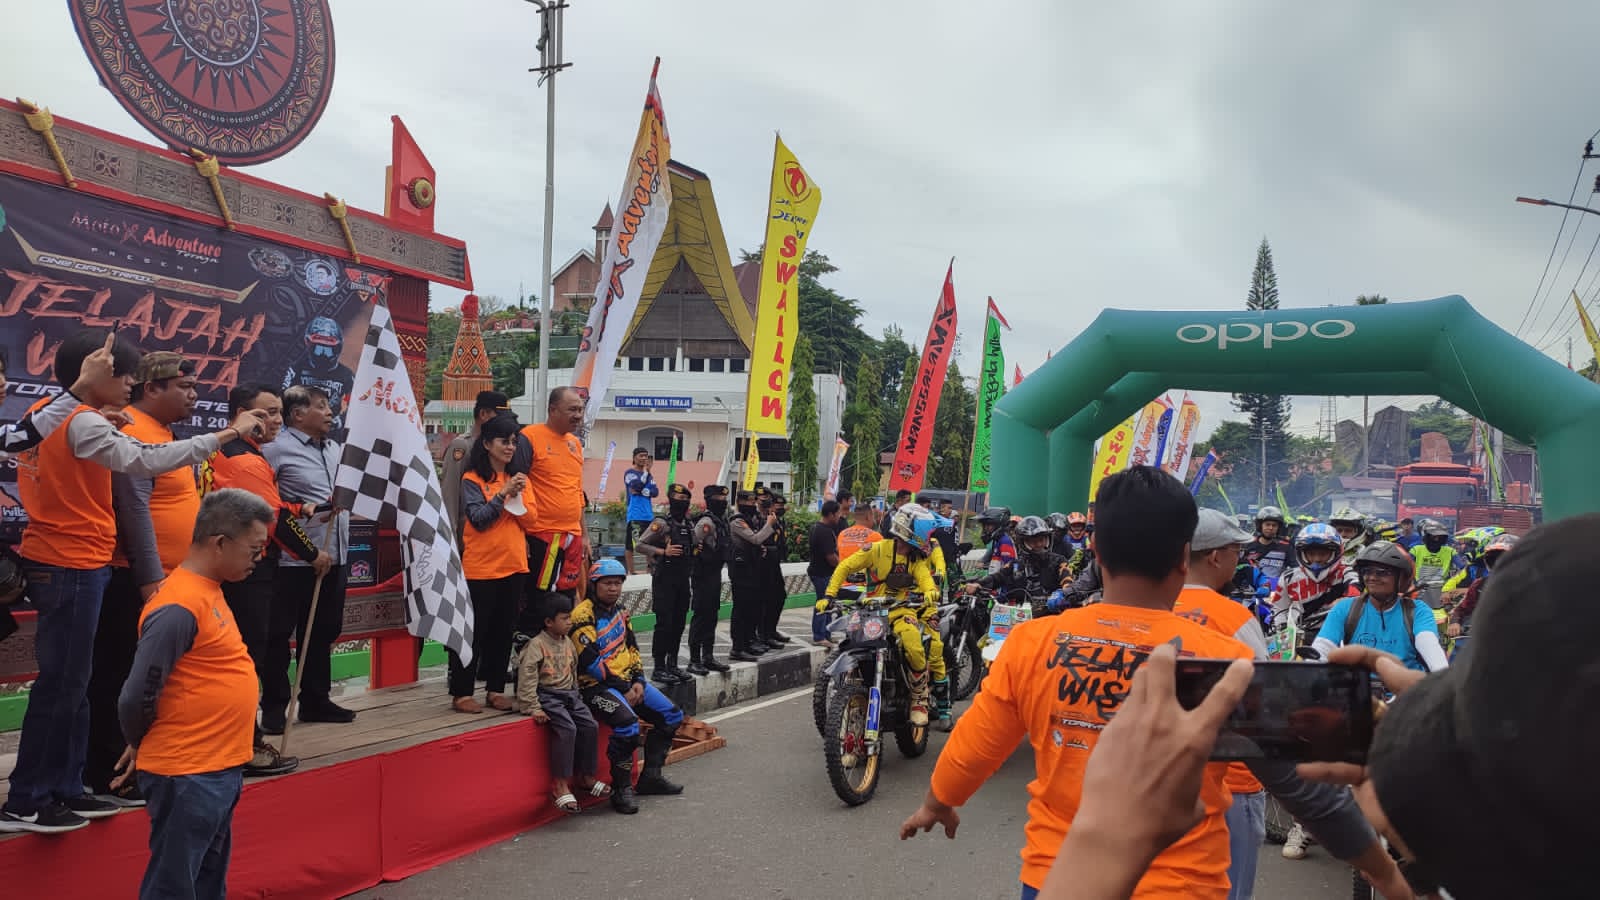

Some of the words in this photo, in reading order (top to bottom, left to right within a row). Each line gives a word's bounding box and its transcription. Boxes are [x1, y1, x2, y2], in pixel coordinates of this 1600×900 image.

[617, 119, 659, 258] Adventu
[143, 227, 222, 257] Adventure
[74, 262, 108, 274] DAY
[0, 267, 266, 357] JELAJAH
[1176, 318, 1356, 350] oppo
[1103, 430, 1126, 476] SWAL
[1046, 640, 1152, 681] JELAJ
[1058, 674, 1131, 708] WIS
